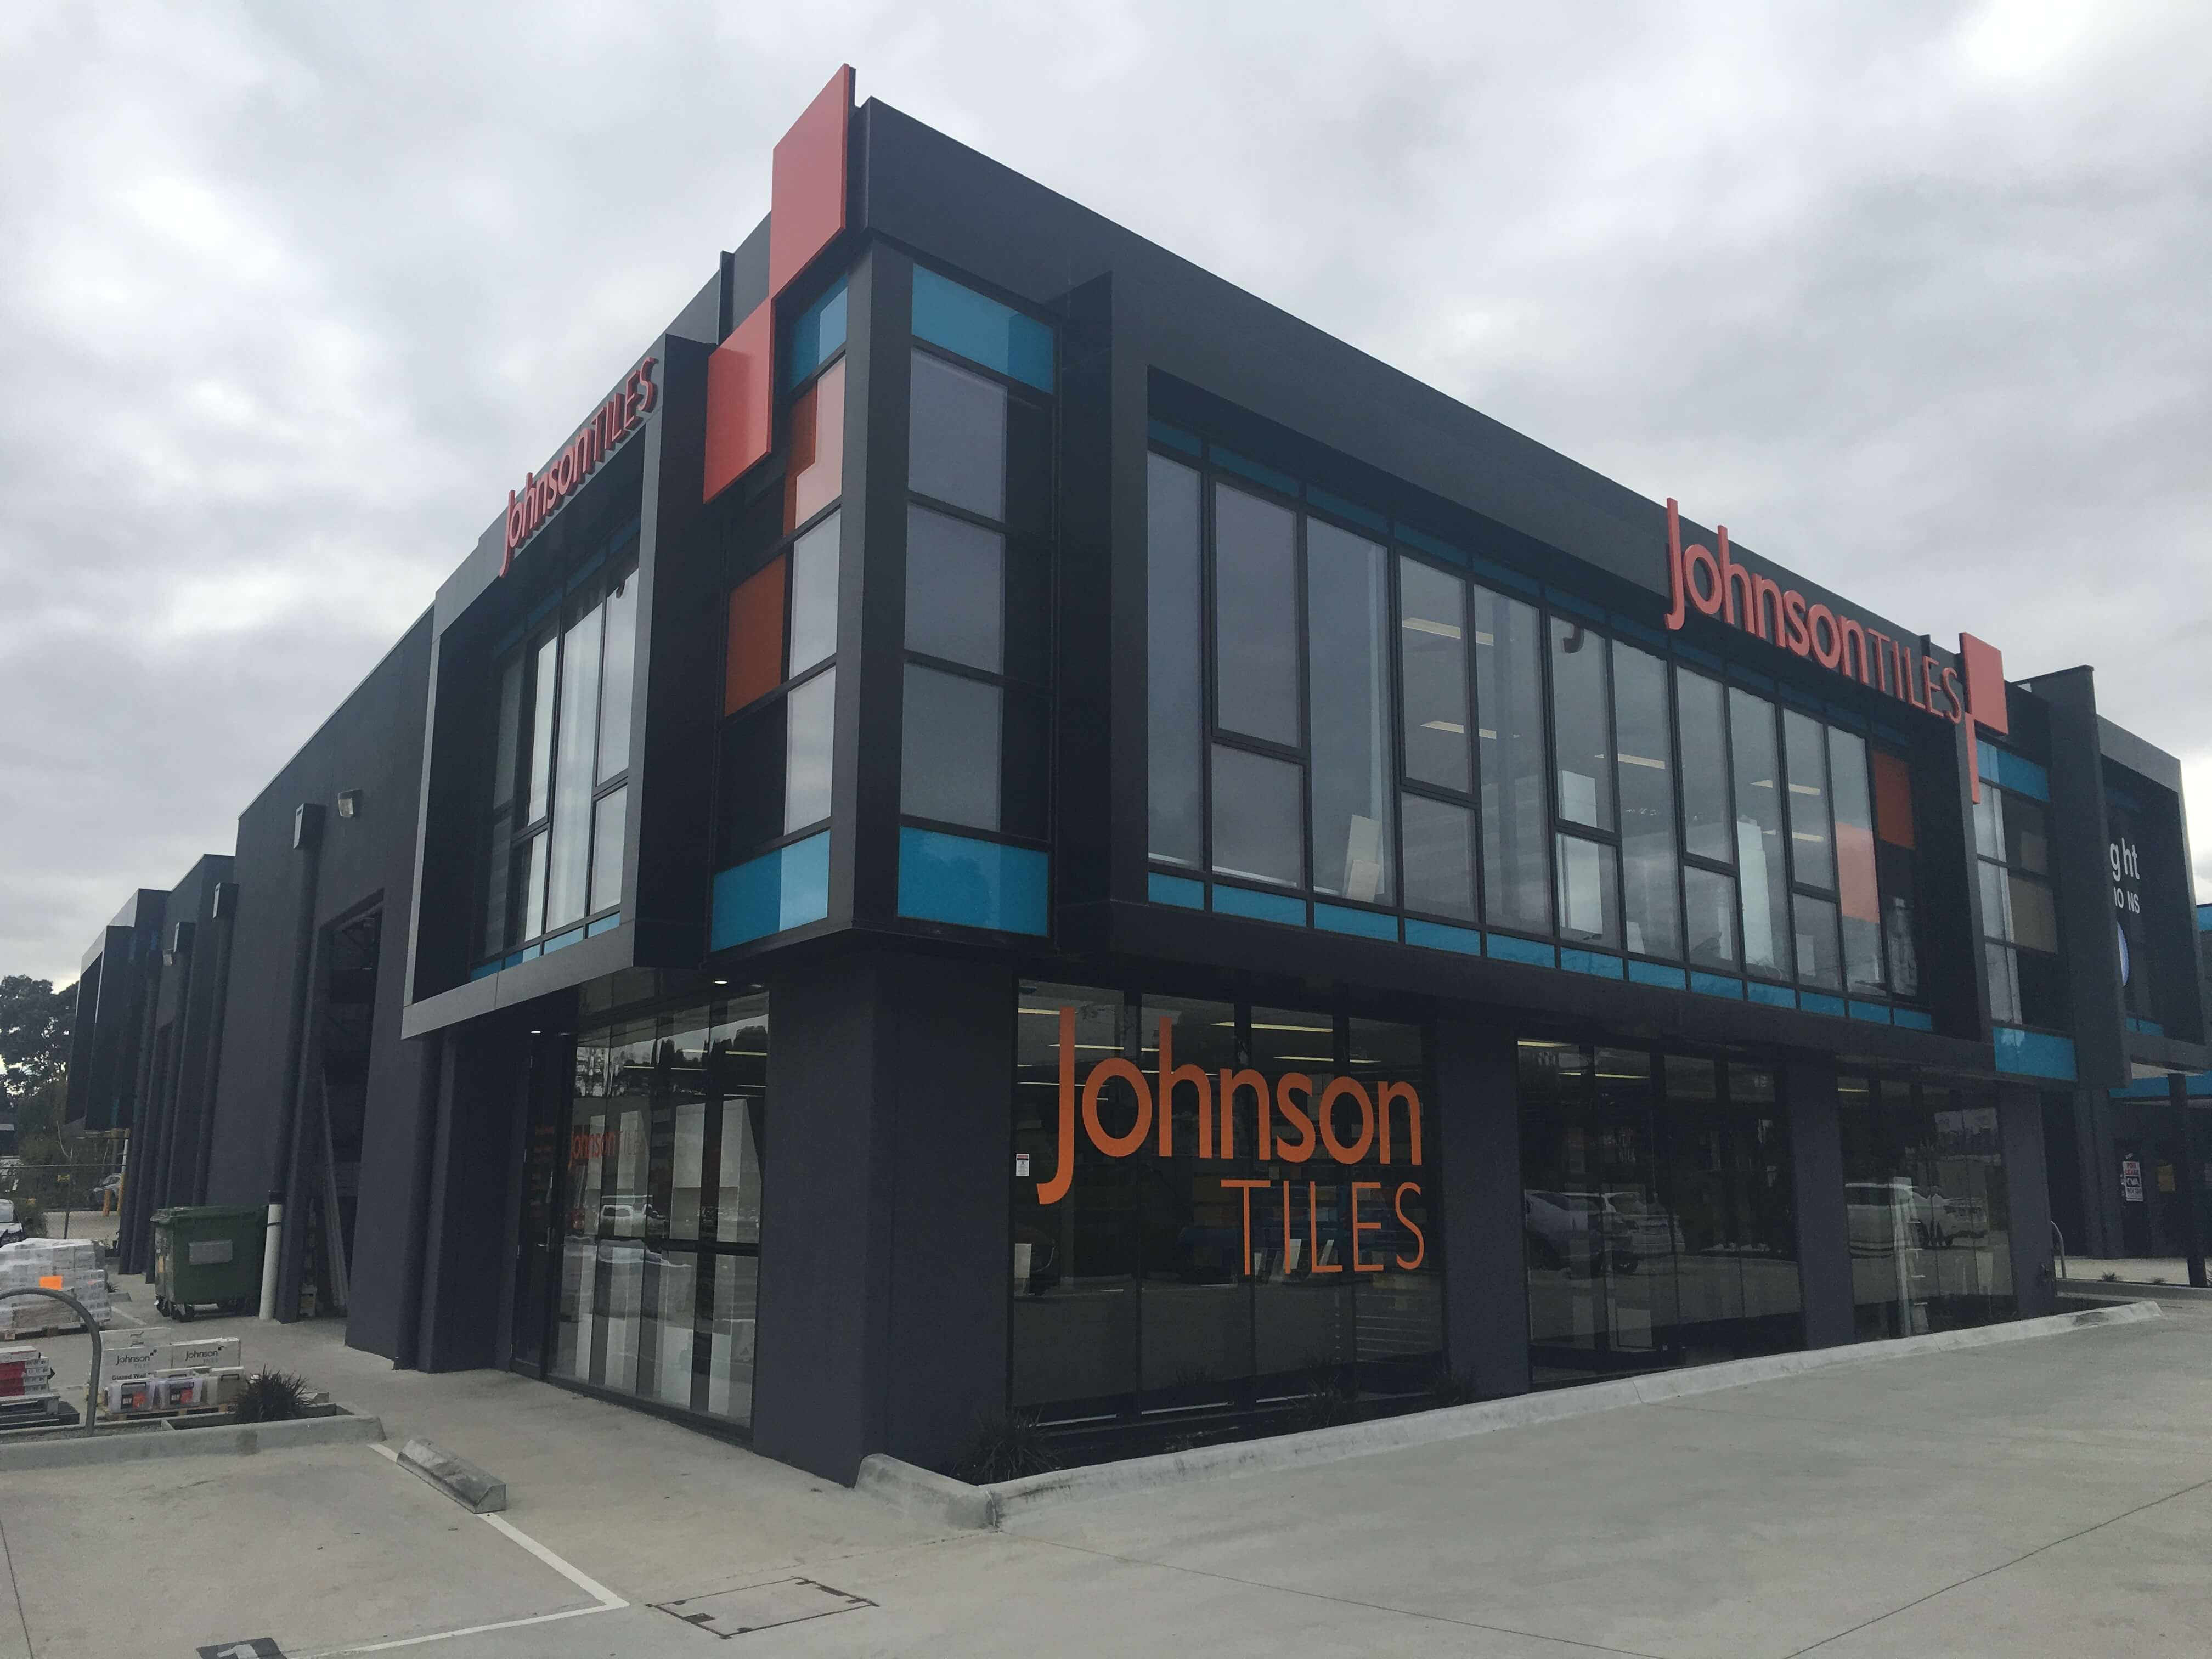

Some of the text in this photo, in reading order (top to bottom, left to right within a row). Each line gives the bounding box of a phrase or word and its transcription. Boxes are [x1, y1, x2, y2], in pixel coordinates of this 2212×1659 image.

[499, 357, 658, 578] Johnson TILES
[1665, 497, 1961, 724] Johnson TILES
[1036, 1006, 1423, 1205] Johnson
[1221, 1179, 1425, 1276] TILES
[116, 1354, 150, 1365] Johnson
[184, 1350, 218, 1361] Johnson
